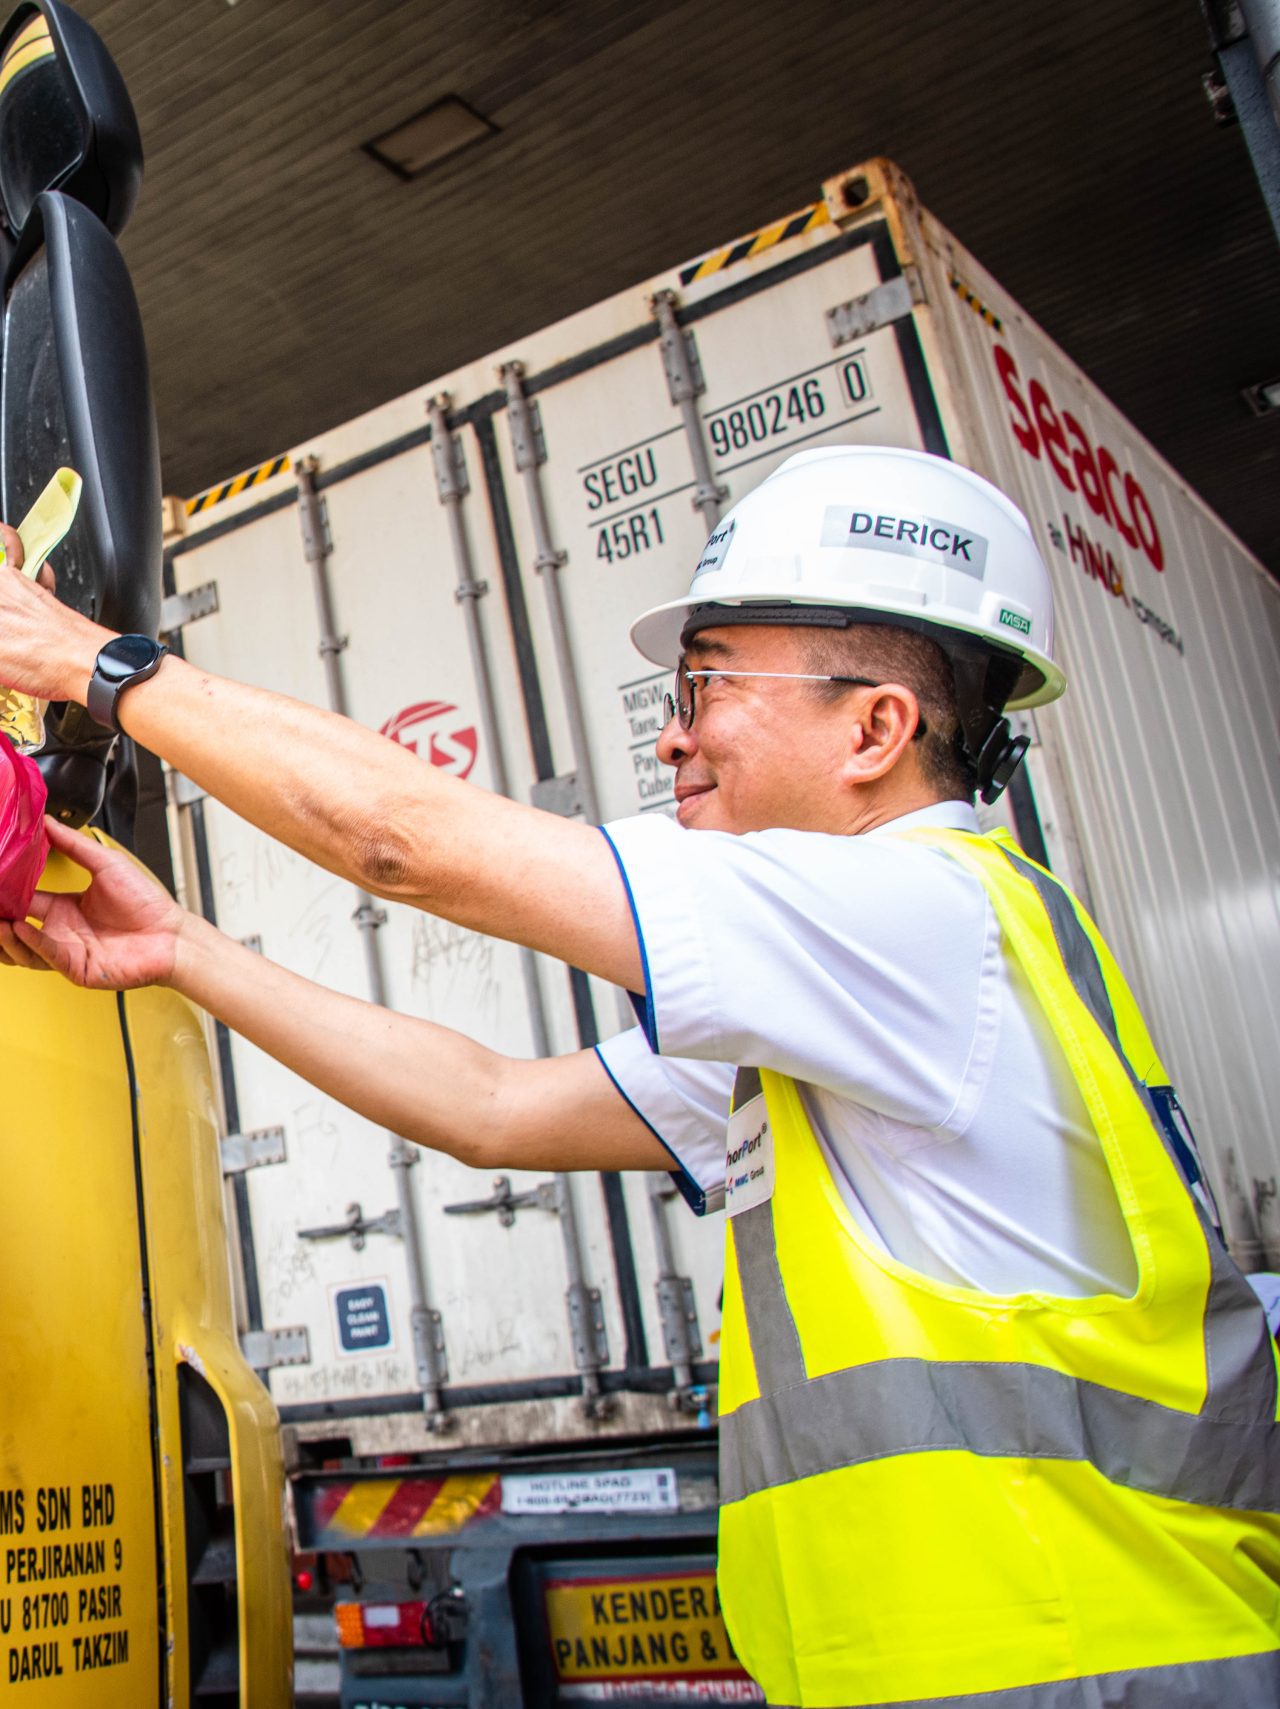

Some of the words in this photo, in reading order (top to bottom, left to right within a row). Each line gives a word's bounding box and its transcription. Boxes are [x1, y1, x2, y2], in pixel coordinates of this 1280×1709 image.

[583, 448, 658, 510] SEGU
[710, 378, 825, 457] 980246
[842, 360, 867, 402] 0
[994, 344, 1164, 573] seaco
[597, 508, 665, 564] 45R1
[849, 512, 972, 561] DERICK
[1000, 609, 1031, 635] MSA
[623, 682, 664, 713] MGW
[637, 774, 674, 800] Cube
[749, 1165, 765, 1181] Group
[36, 1486, 71, 1533] SDN
[82, 1483, 115, 1528] BHD
[530, 1478, 589, 1492] HOTLINE
[6, 1540, 106, 1585] PERJIRANAN
[113, 1537, 123, 1572] 9
[22, 1591, 69, 1632] 81700
[78, 1584, 122, 1623] PASIR
[8, 1641, 63, 1684] DARUL
[72, 1629, 129, 1672] TAKZIM
[555, 1631, 690, 1669] PANJANG
[700, 1629, 718, 1661] &
